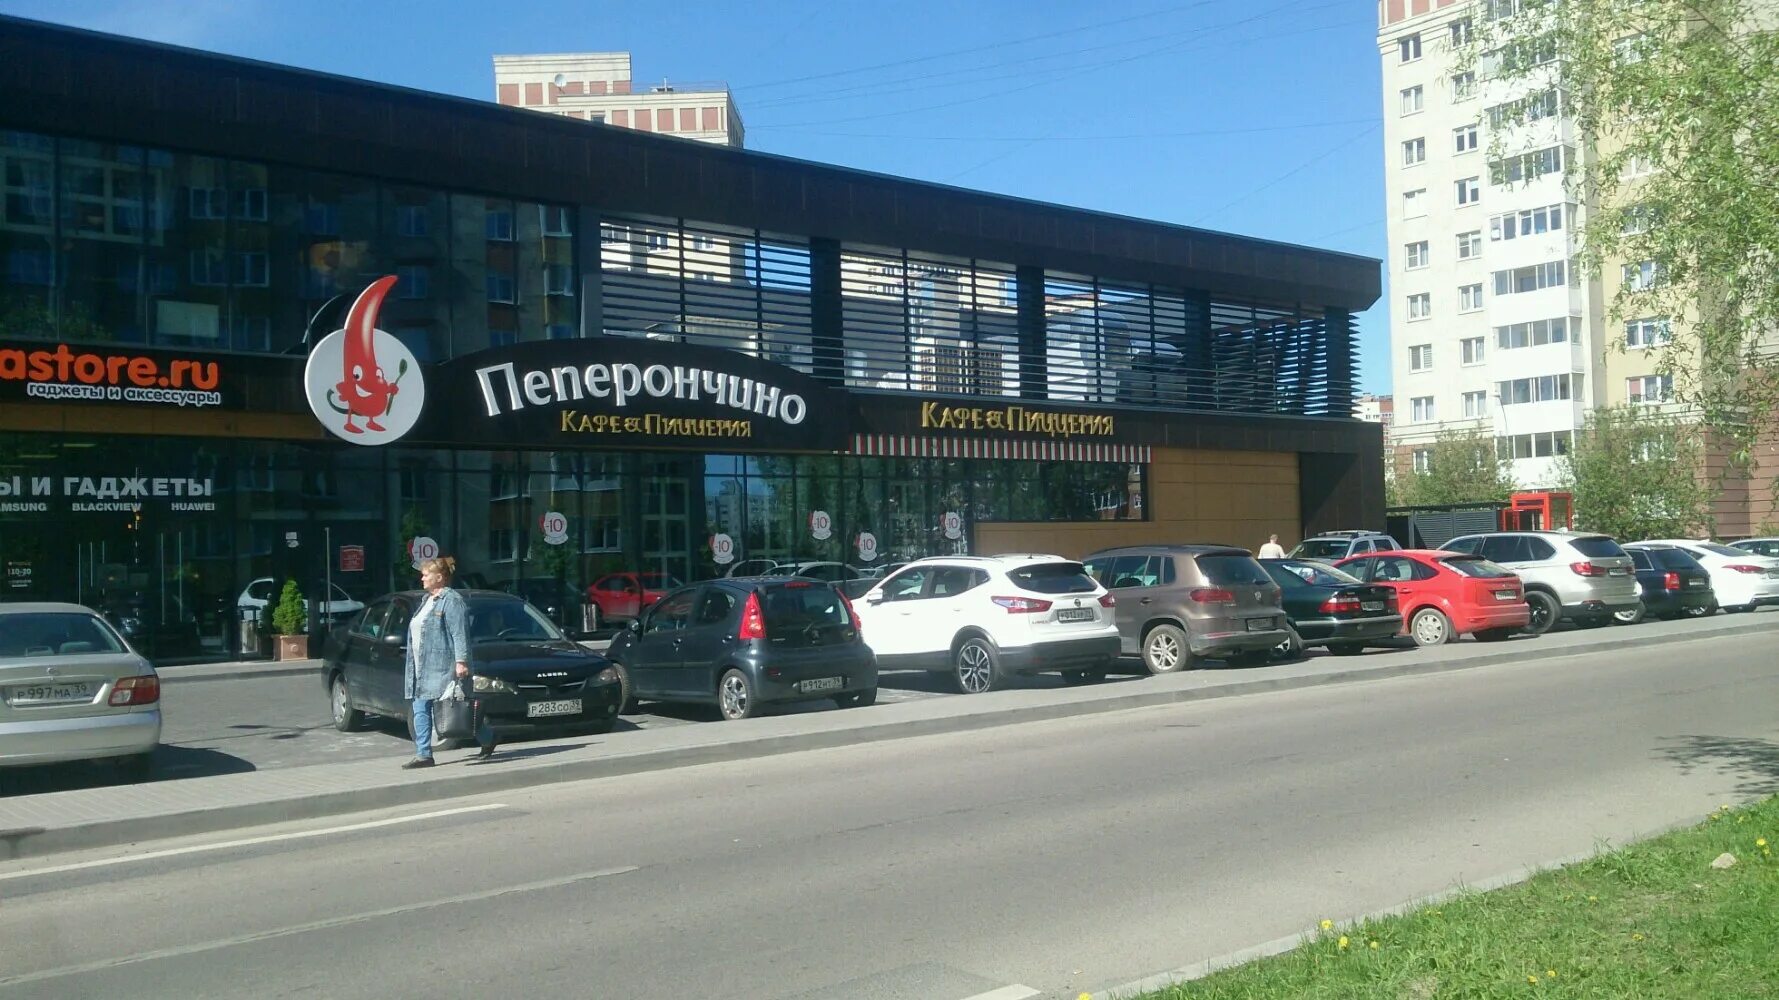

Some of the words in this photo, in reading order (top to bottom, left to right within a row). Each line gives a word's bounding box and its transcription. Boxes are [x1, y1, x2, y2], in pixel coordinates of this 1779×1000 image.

[27, 382, 105, 399] гаджеты
[108, 386, 121, 400] и
[124, 388, 220, 406] аксессуары
[475, 360, 806, 425] Пеперончино
[31, 477, 51, 496] И
[63, 477, 212, 499] ГАДЖЕТЫ
[0, 502, 47, 512] MSUNG
[72, 502, 141, 512] BLACKVIEW
[171, 503, 215, 512] HUAWEI
[414, 544, 434, 559] -10
